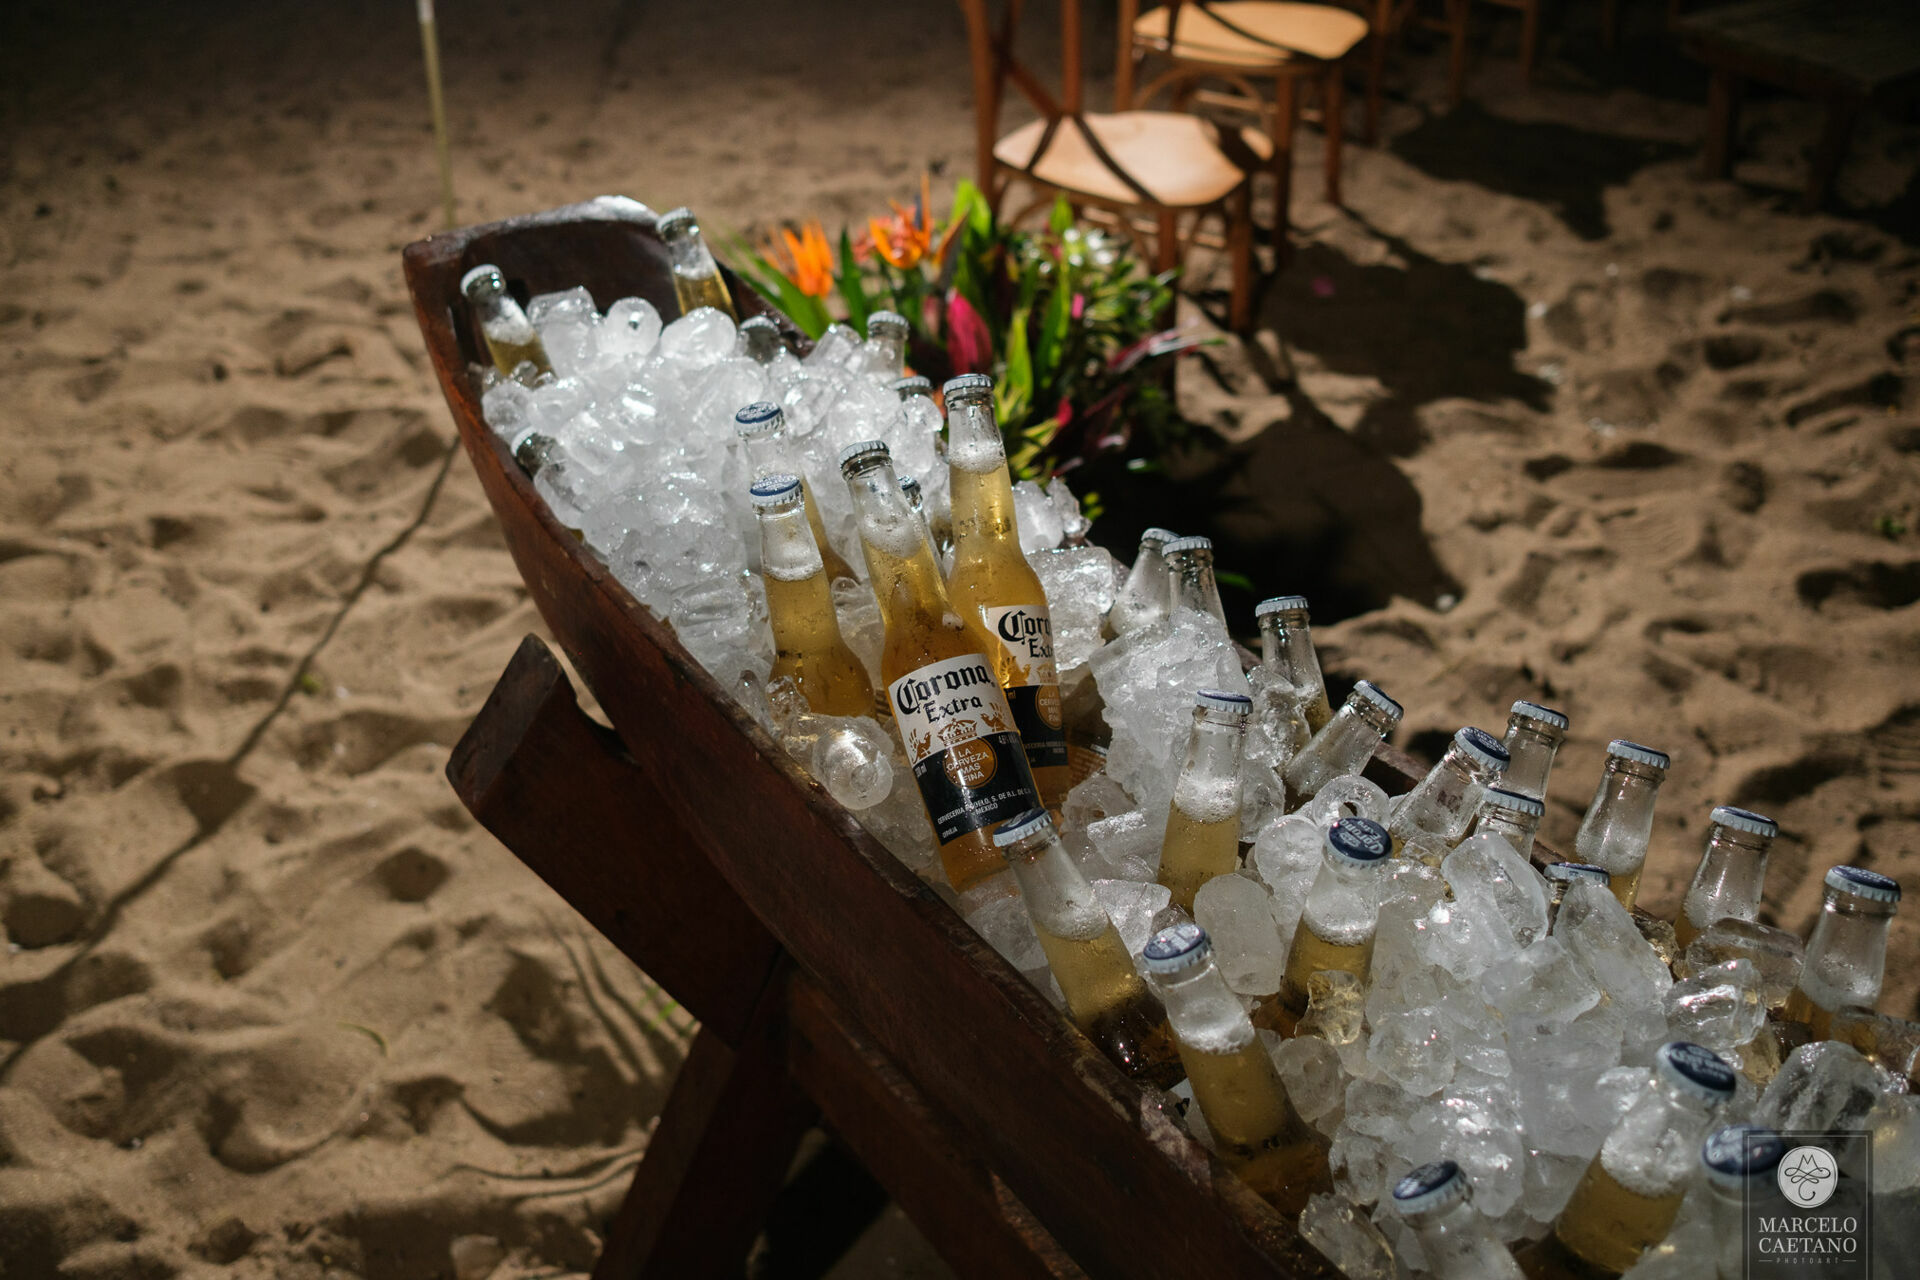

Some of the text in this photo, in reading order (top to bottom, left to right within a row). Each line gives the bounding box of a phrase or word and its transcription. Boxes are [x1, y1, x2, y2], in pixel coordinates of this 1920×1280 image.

[897, 665, 991, 715] Corona
[923, 696, 983, 723] Extra
[946, 751, 989, 771] CRVEZA
[958, 748, 971, 757] LA
